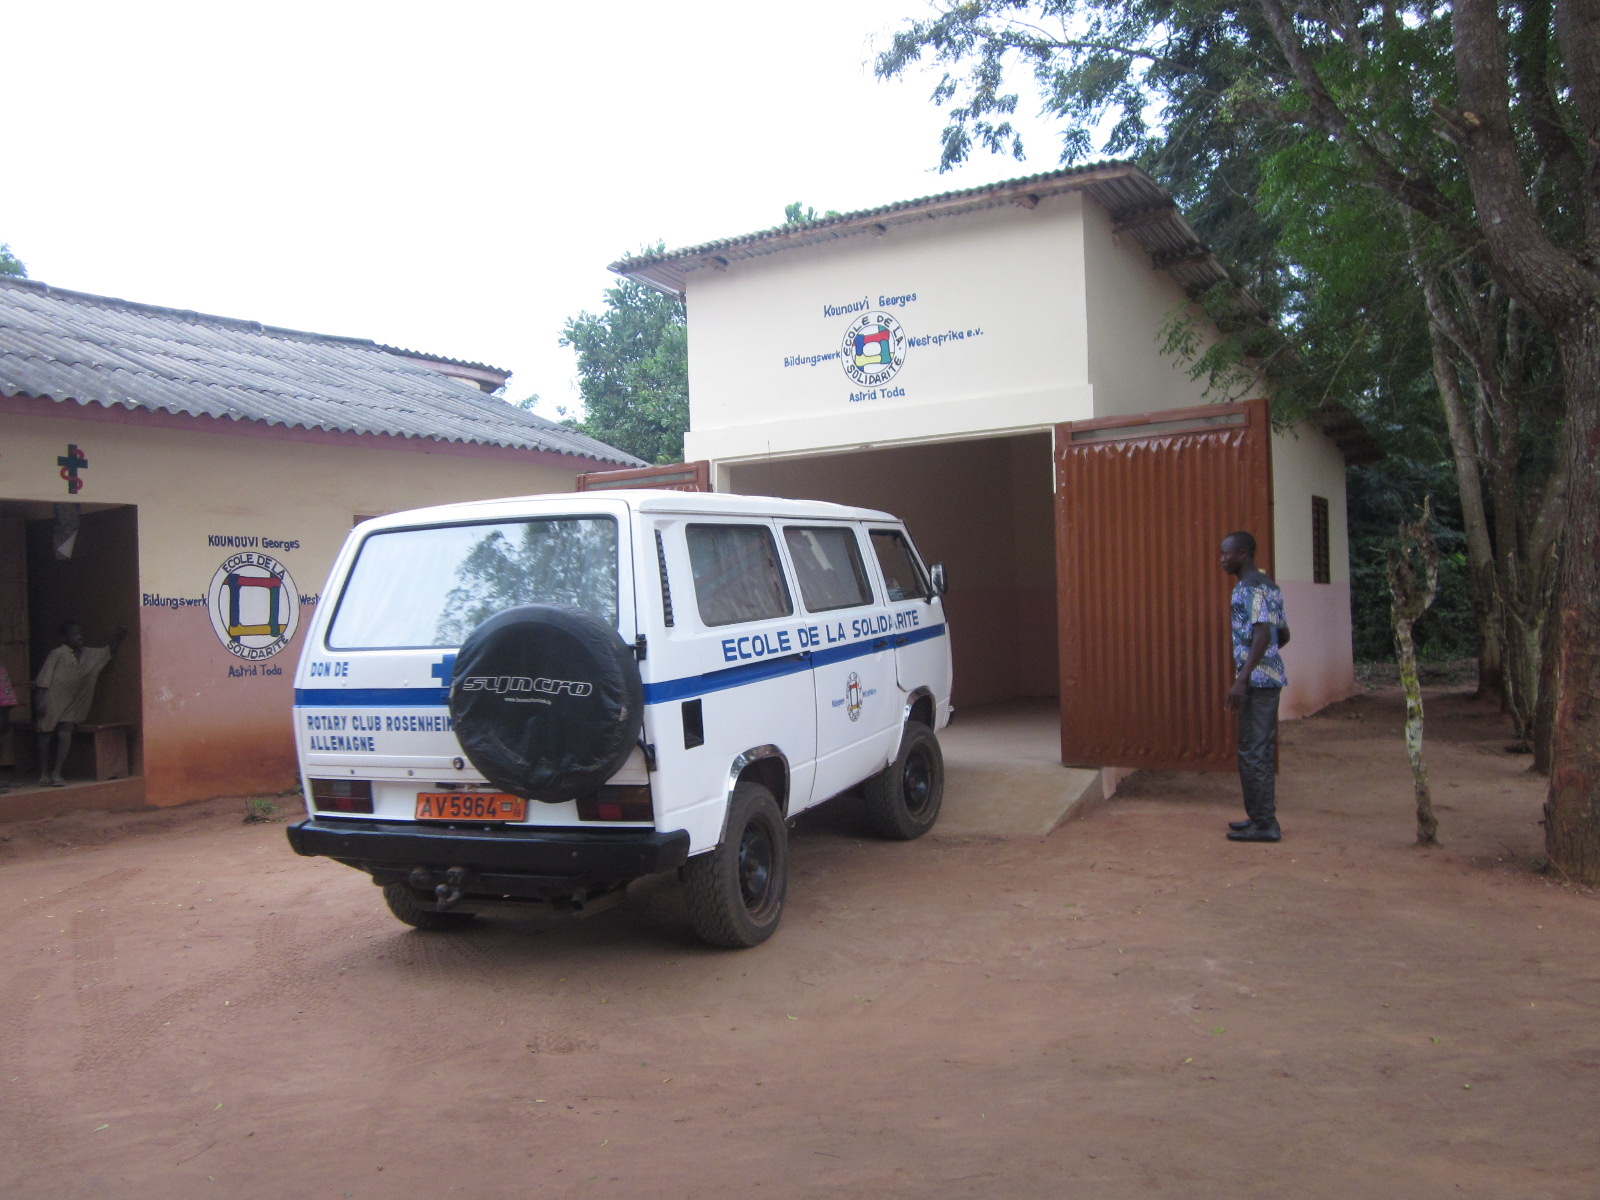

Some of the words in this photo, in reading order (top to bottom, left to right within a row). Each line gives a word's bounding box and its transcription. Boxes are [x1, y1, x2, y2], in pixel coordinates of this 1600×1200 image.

[824, 296, 869, 318] Kounouvi
[879, 292, 917, 308] Georges
[843, 315, 870, 357] ECOLE
[876, 315, 893, 328] DE
[895, 326, 904, 347] LA
[784, 351, 841, 368] Bildungswerk
[846, 356, 902, 386] SOLIDARITE
[849, 389, 877, 402] Astrid
[880, 387, 905, 398] Toda
[208, 535, 259, 548] KOUNOUVI
[262, 537, 300, 551] Georges
[222, 553, 254, 574] ECOLE
[257, 555, 272, 569] DE
[272, 563, 286, 580] LA
[142, 593, 208, 610] Bildungswerk
[300, 593, 321, 605] West
[721, 630, 792, 663] ECOLE
[798, 626, 820, 648] DE
[826, 622, 847, 643] LA
[852, 610, 920, 638] SOLIDARITE
[226, 634, 289, 660] SOLIDARITE
[228, 665, 257, 678] Astrid
[260, 664, 282, 675] Toda
[310, 662, 332, 677] DON
[335, 661, 348, 677] DE
[307, 715, 347, 731] ROTARY
[352, 716, 382, 731] CLUB
[310, 735, 375, 751] ALLEMAGNE
